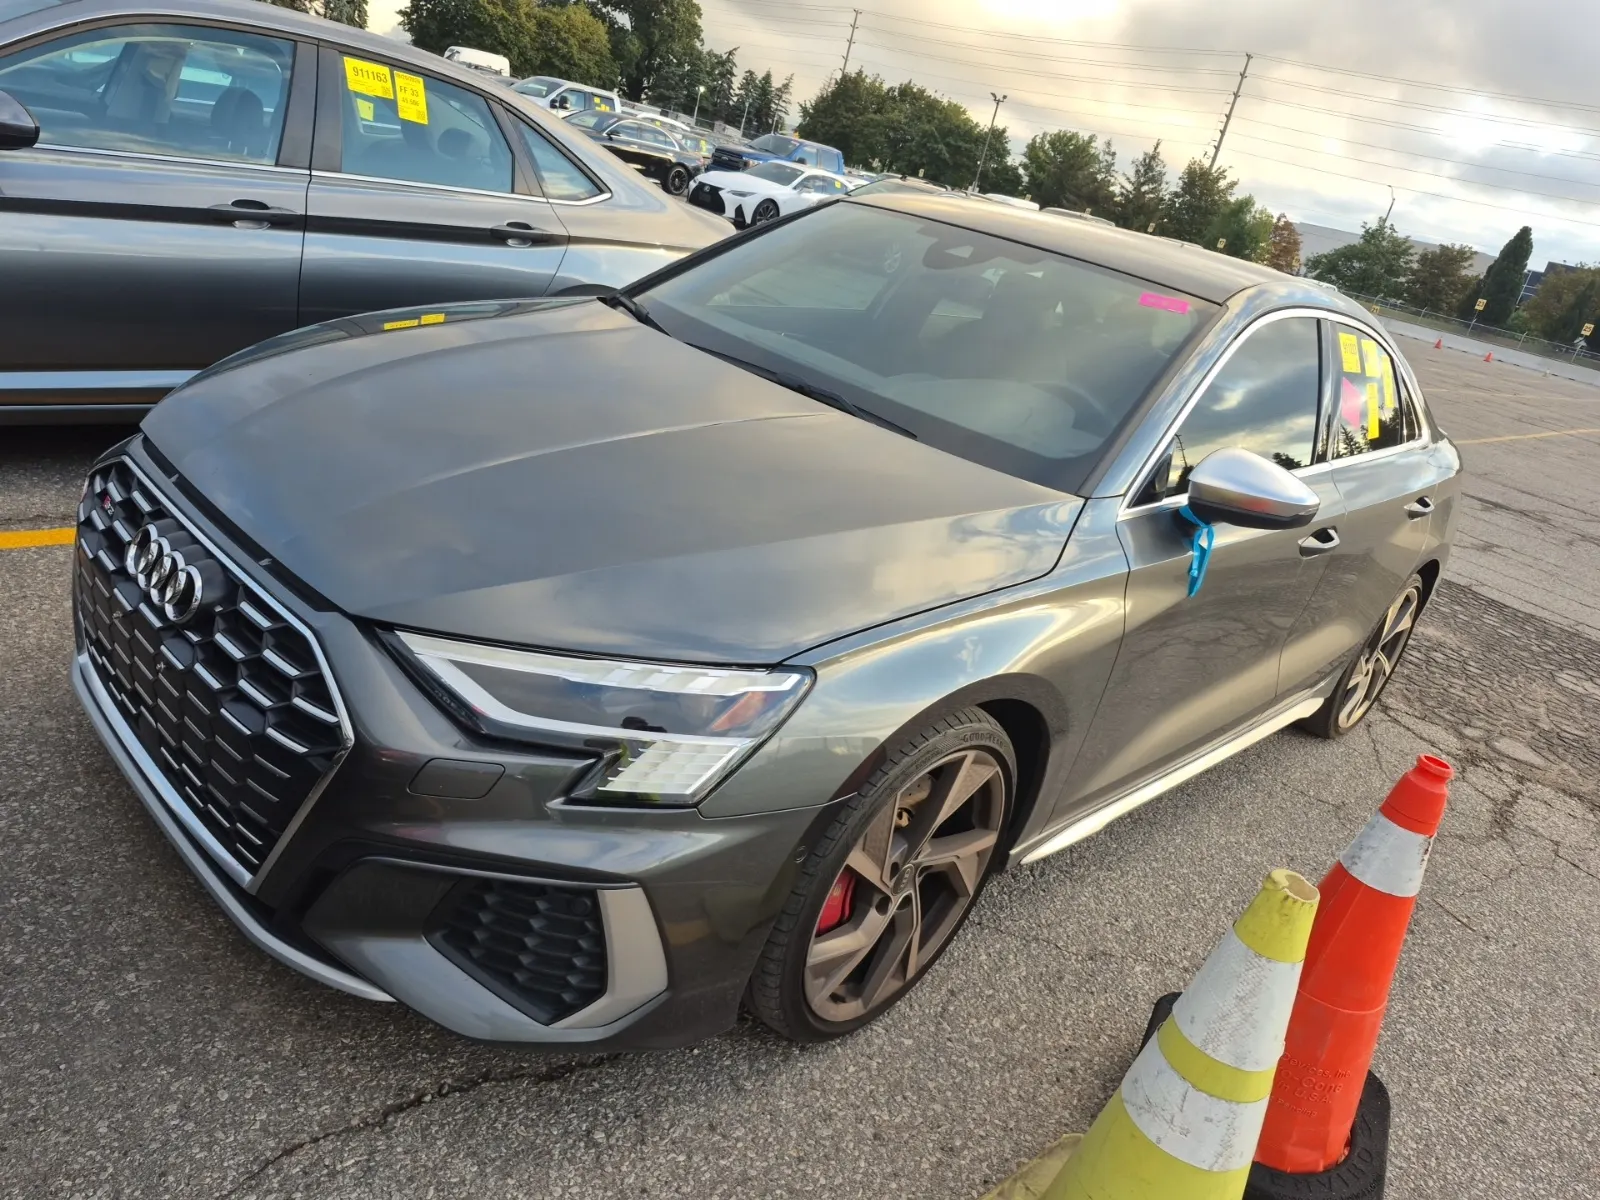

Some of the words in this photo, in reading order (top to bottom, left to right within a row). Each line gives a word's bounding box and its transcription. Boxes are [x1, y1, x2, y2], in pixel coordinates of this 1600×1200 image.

[352, 66, 387, 83] 911163
[399, 85, 408, 94] FF
[1294, 1087, 1333, 1104] U.S.A.
